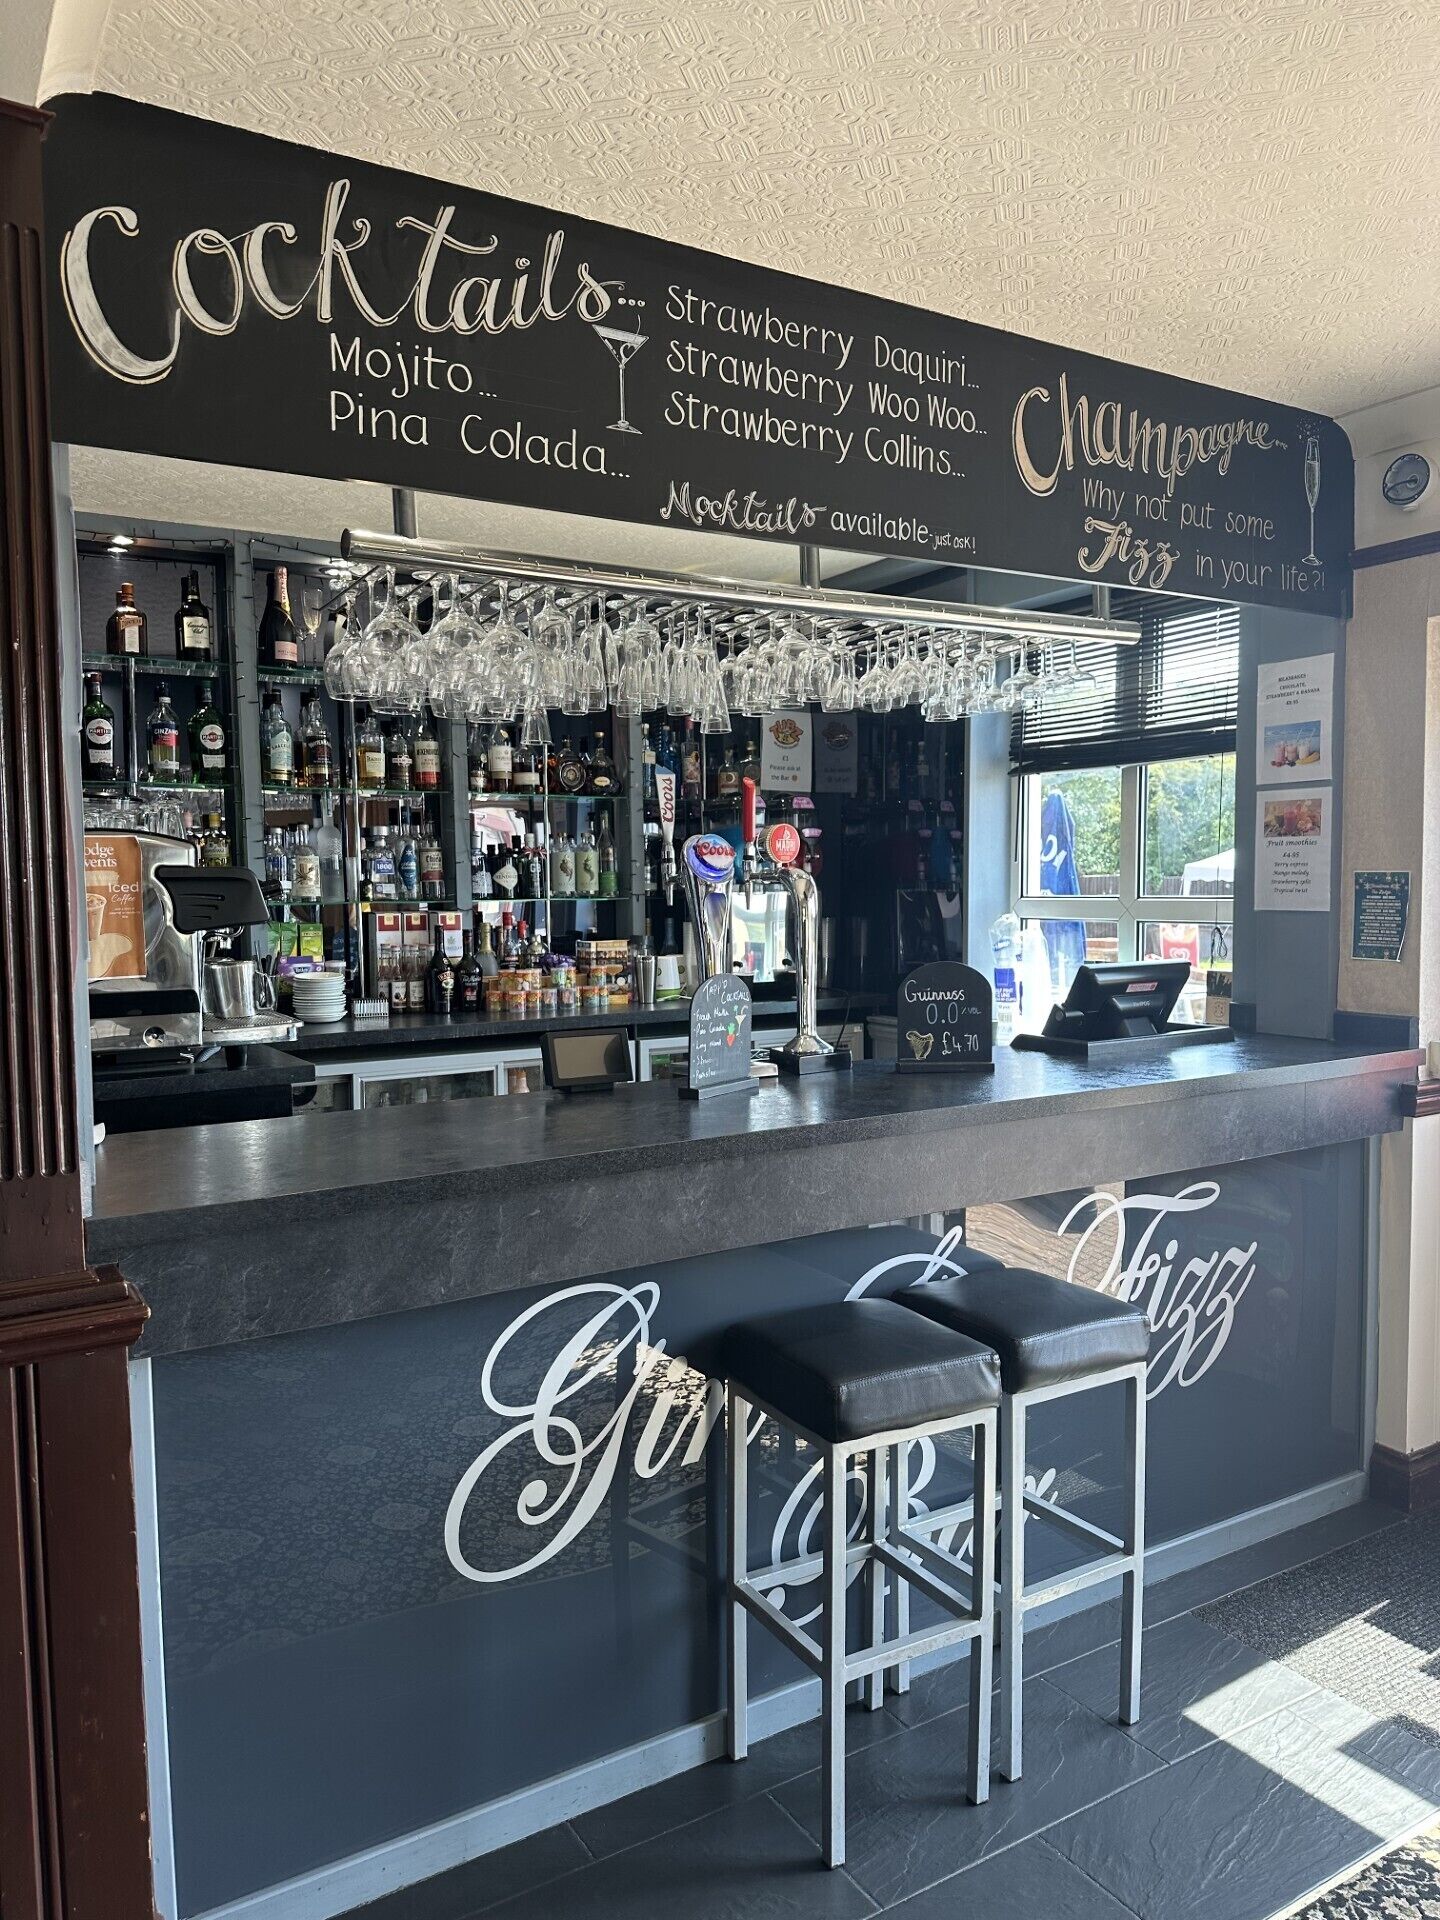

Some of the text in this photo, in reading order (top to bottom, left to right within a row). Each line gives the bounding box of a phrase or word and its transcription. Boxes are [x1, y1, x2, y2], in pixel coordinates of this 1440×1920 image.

[665, 284, 854, 370] Strawberry
[666, 340, 854, 416] Strawberry
[868, 381, 919, 422] Woo
[329, 391, 430, 446] Pina
[664, 391, 854, 464] Strawberry
[660, 480, 828, 534] Mocktails
[953, 536, 976, 554] ask!
[1083, 478, 1276, 540] Why not put some
[1078, 516, 1181, 589] Fizz
[1196, 549, 1214, 577] in
[1221, 560, 1273, 589] your
[660, 776, 674, 823] Coors
[84, 843, 114, 858] odge
[84, 858, 117, 868] vents
[695, 842, 737, 857] Coors
[108, 881, 139, 893] Iced
[111, 893, 136, 905] Coffee
[905, 980, 965, 1003] Guinness
[926, 1002, 959, 1025] 0.0
[942, 1031, 979, 1056] £4.70
[1057, 1181, 1258, 1401] Fizz
